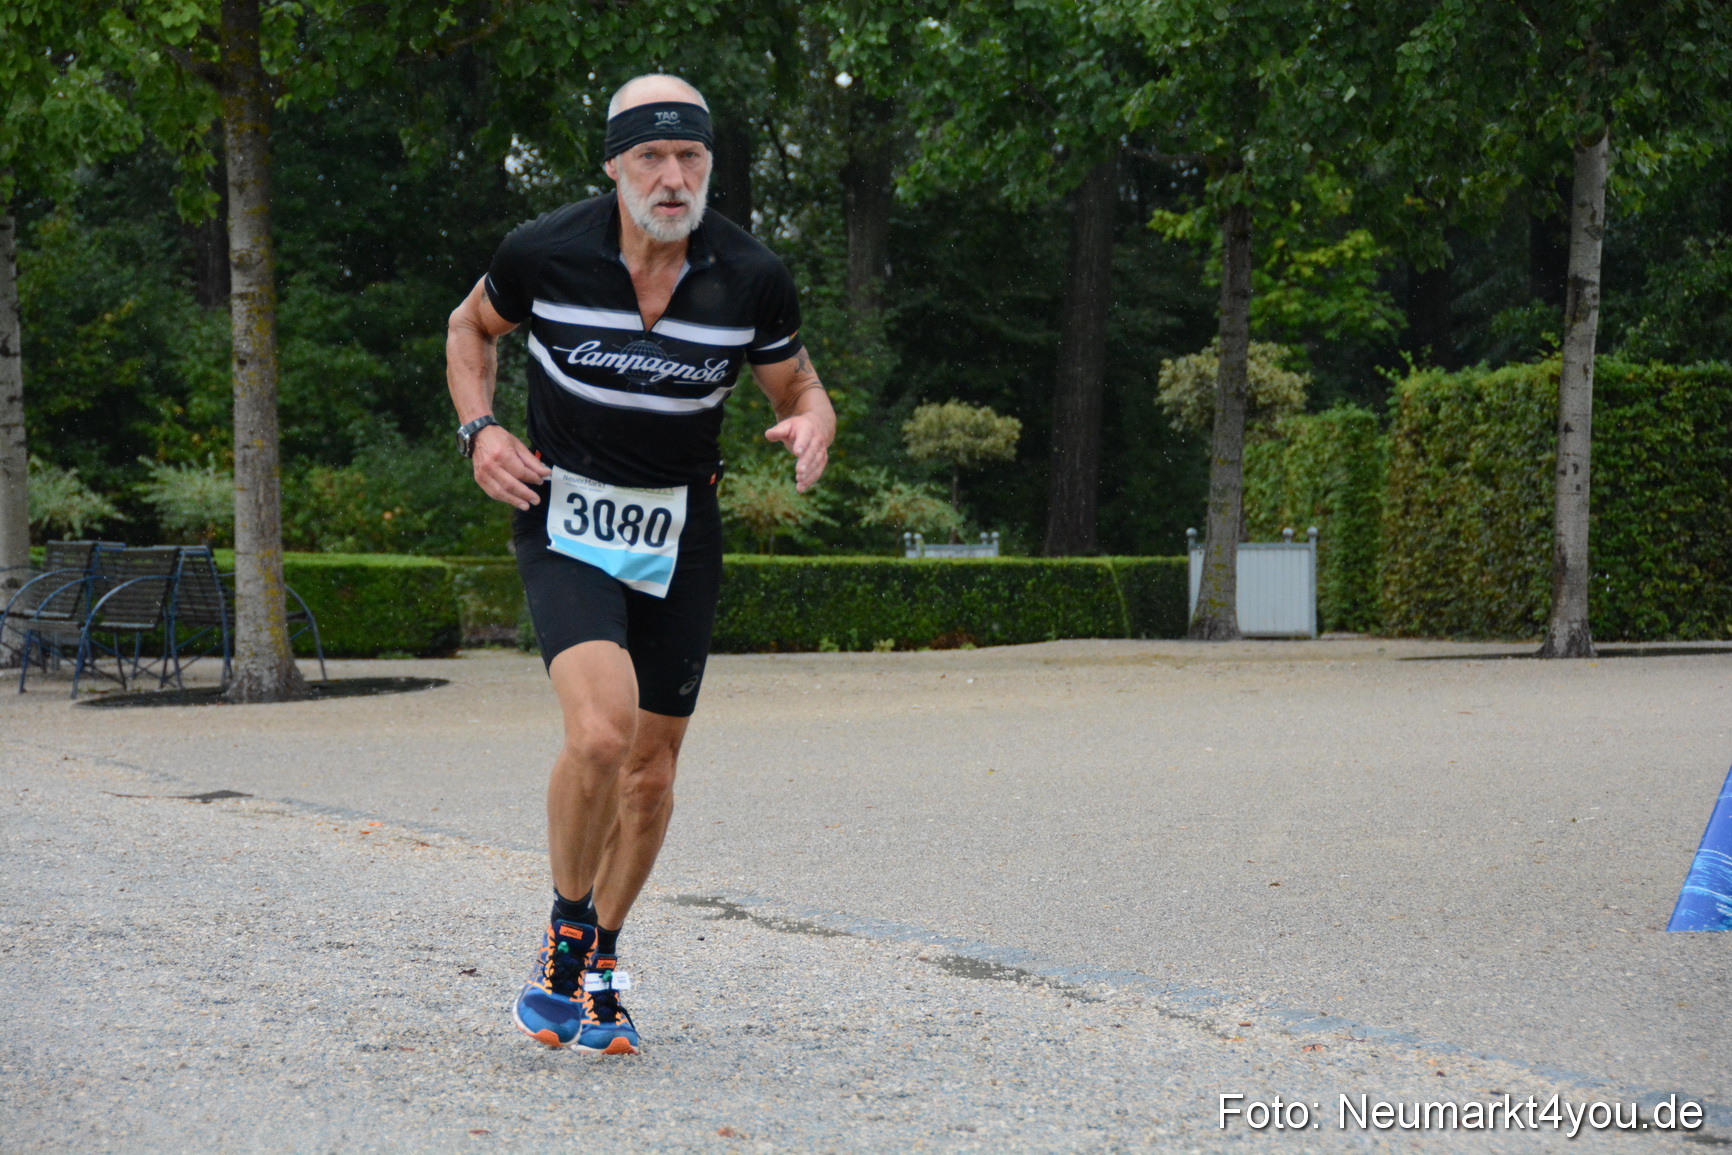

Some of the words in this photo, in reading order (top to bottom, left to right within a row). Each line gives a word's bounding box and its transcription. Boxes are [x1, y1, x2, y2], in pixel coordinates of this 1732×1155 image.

[655, 111, 679, 121] TAO
[552, 340, 730, 384] Campagnolo
[563, 492, 673, 549] 3080
